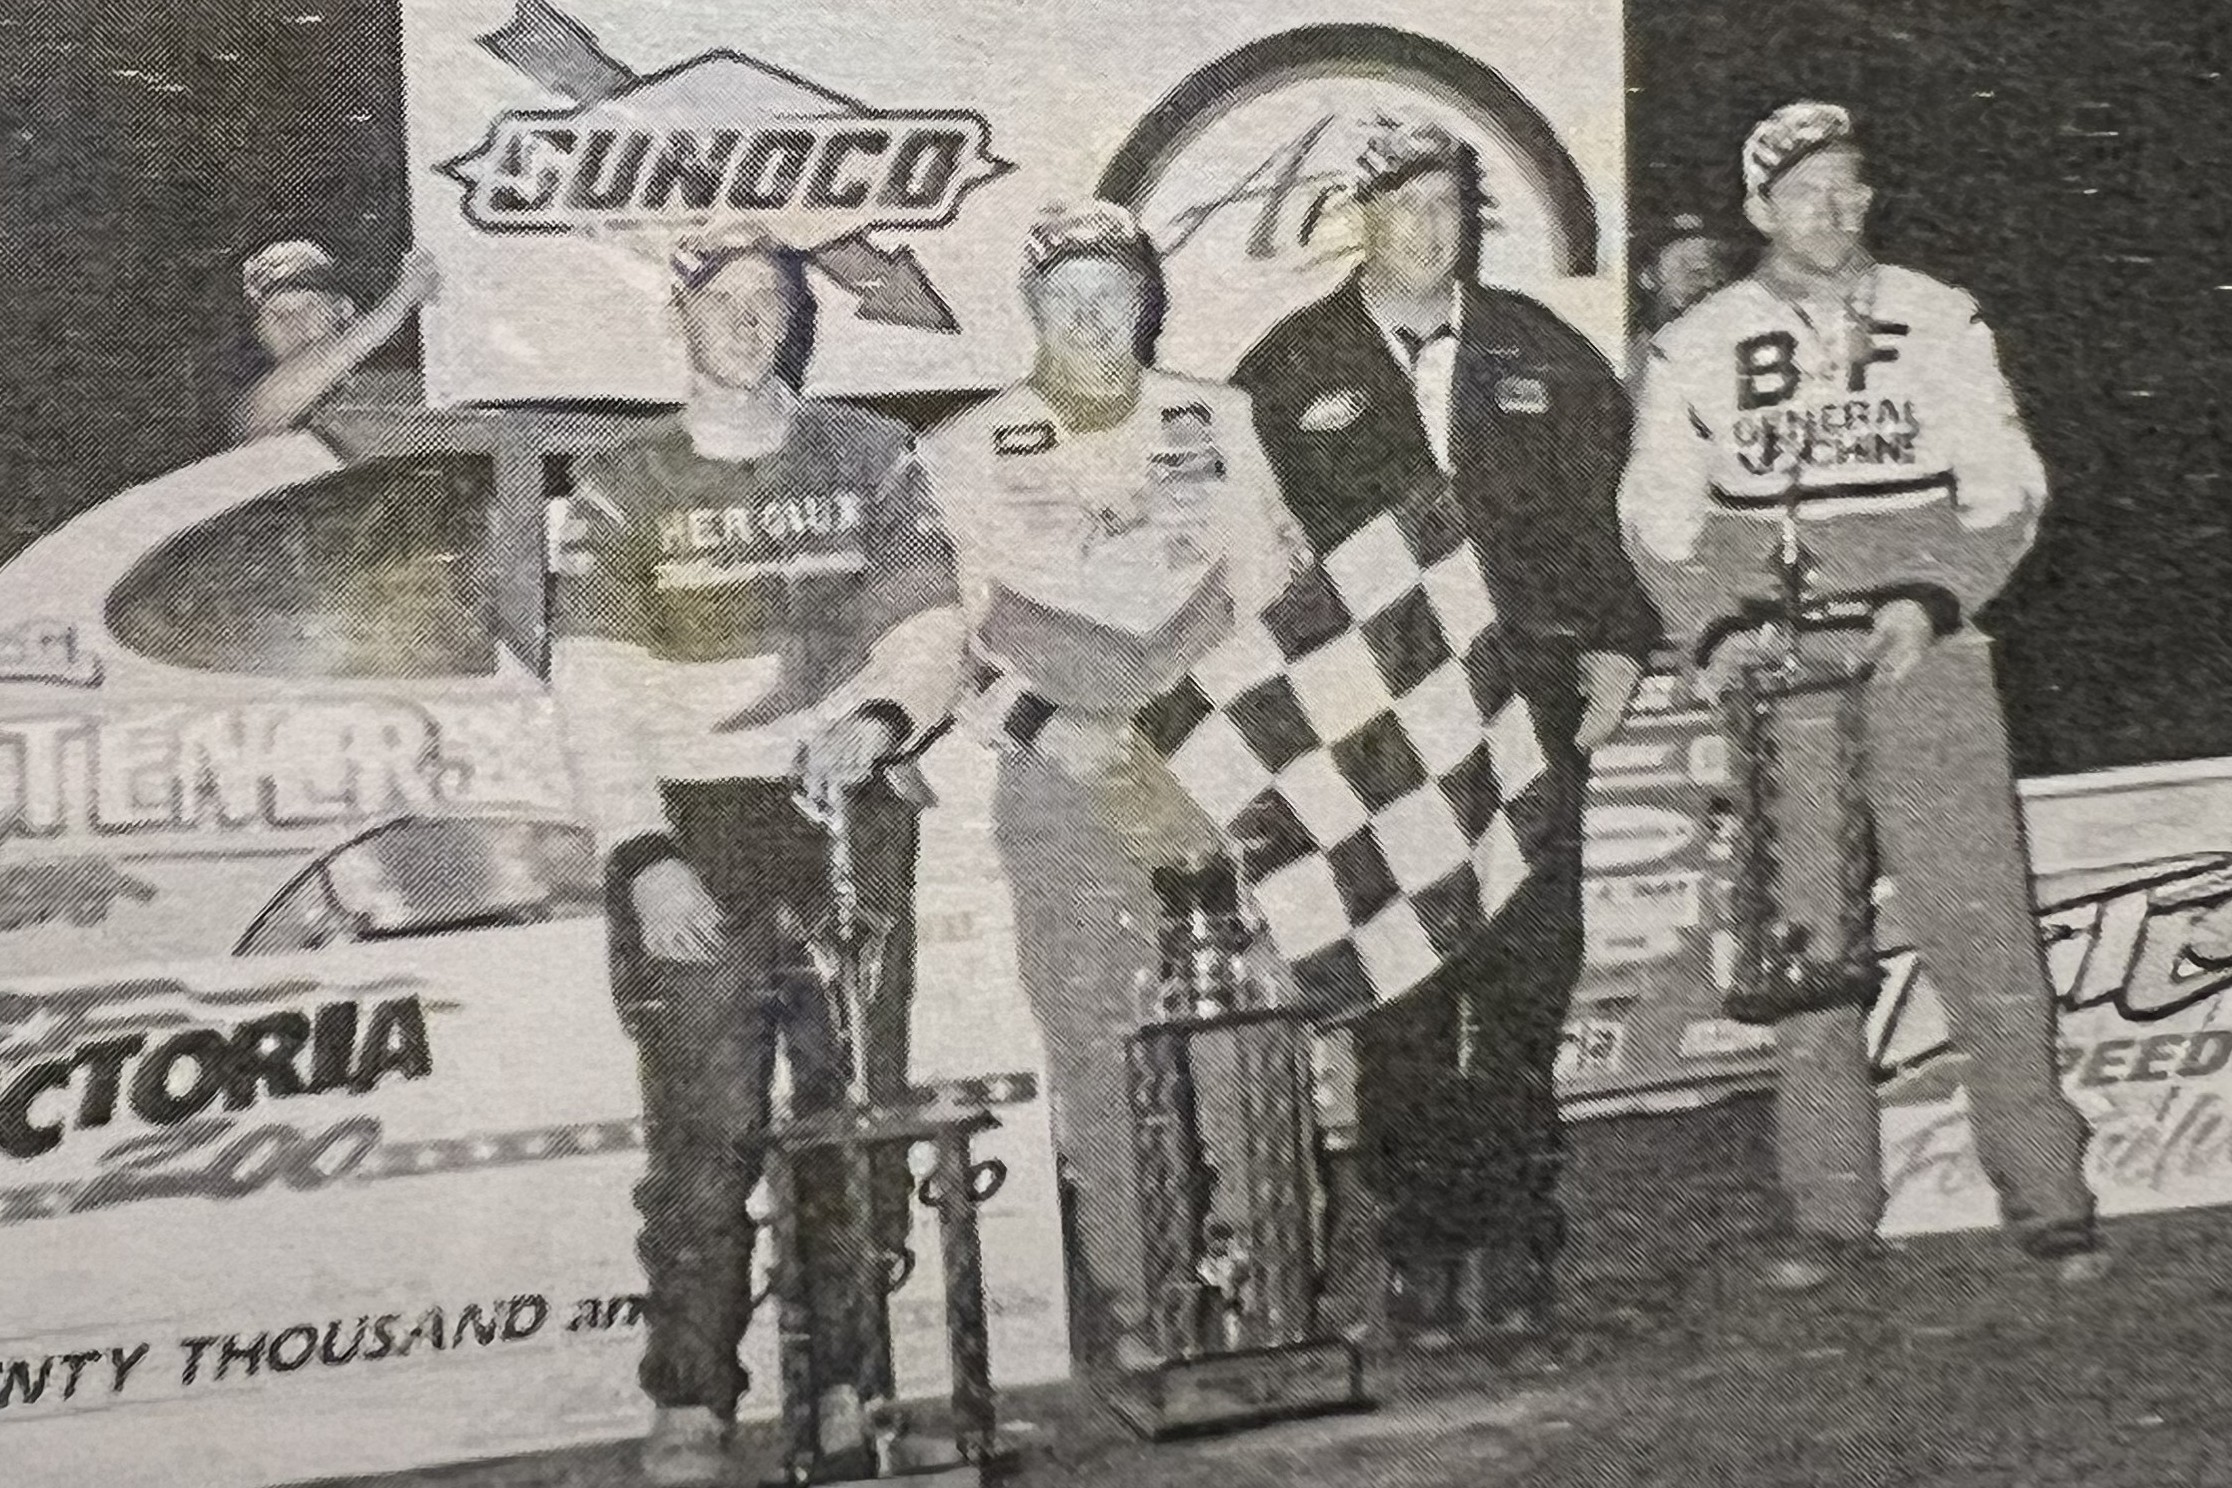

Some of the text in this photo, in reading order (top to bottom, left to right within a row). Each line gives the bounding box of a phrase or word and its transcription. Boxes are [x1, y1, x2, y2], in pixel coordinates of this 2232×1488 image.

[490, 126, 972, 214] SUNOCO
[0, 992, 434, 1160] CTORIA
[178, 1293, 550, 1386] THOUSAND
